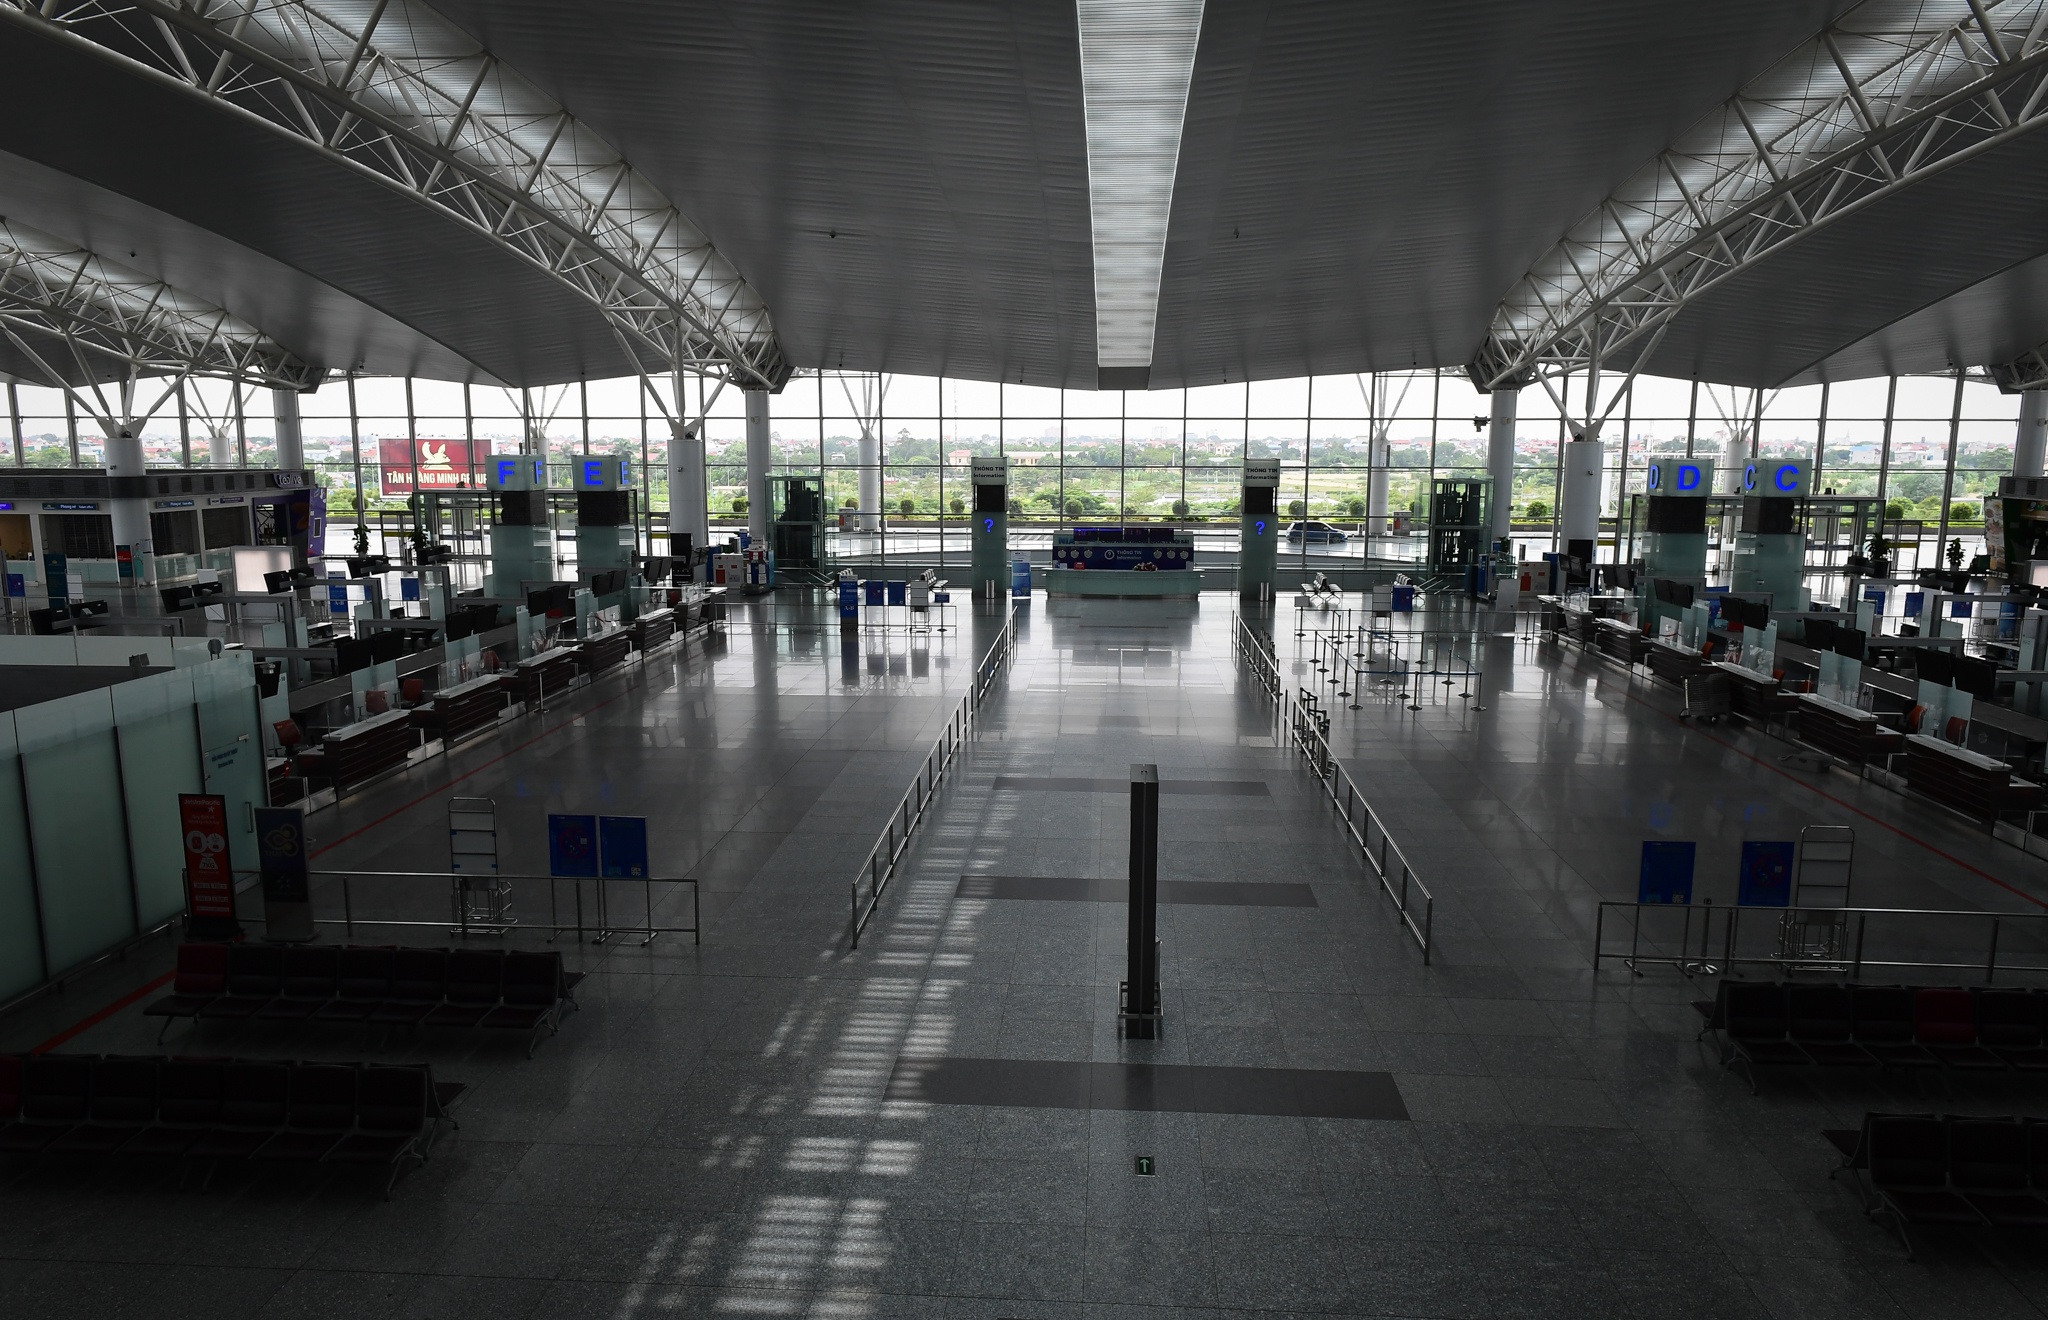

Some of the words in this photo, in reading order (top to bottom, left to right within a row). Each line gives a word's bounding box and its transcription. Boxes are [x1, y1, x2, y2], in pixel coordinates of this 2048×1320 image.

[387, 470, 404, 484] TÂN
[406, 470, 436, 484] HÀNG
[437, 472, 460, 484] MINH
[498, 461, 515, 485] F
[534, 461, 543, 484] F
[584, 461, 603, 485] E
[620, 461, 629, 484] E
[1650, 464, 1659, 490] D
[1678, 465, 1701, 491] D
[1745, 464, 1757, 490] C
[1775, 464, 1799, 492] C
